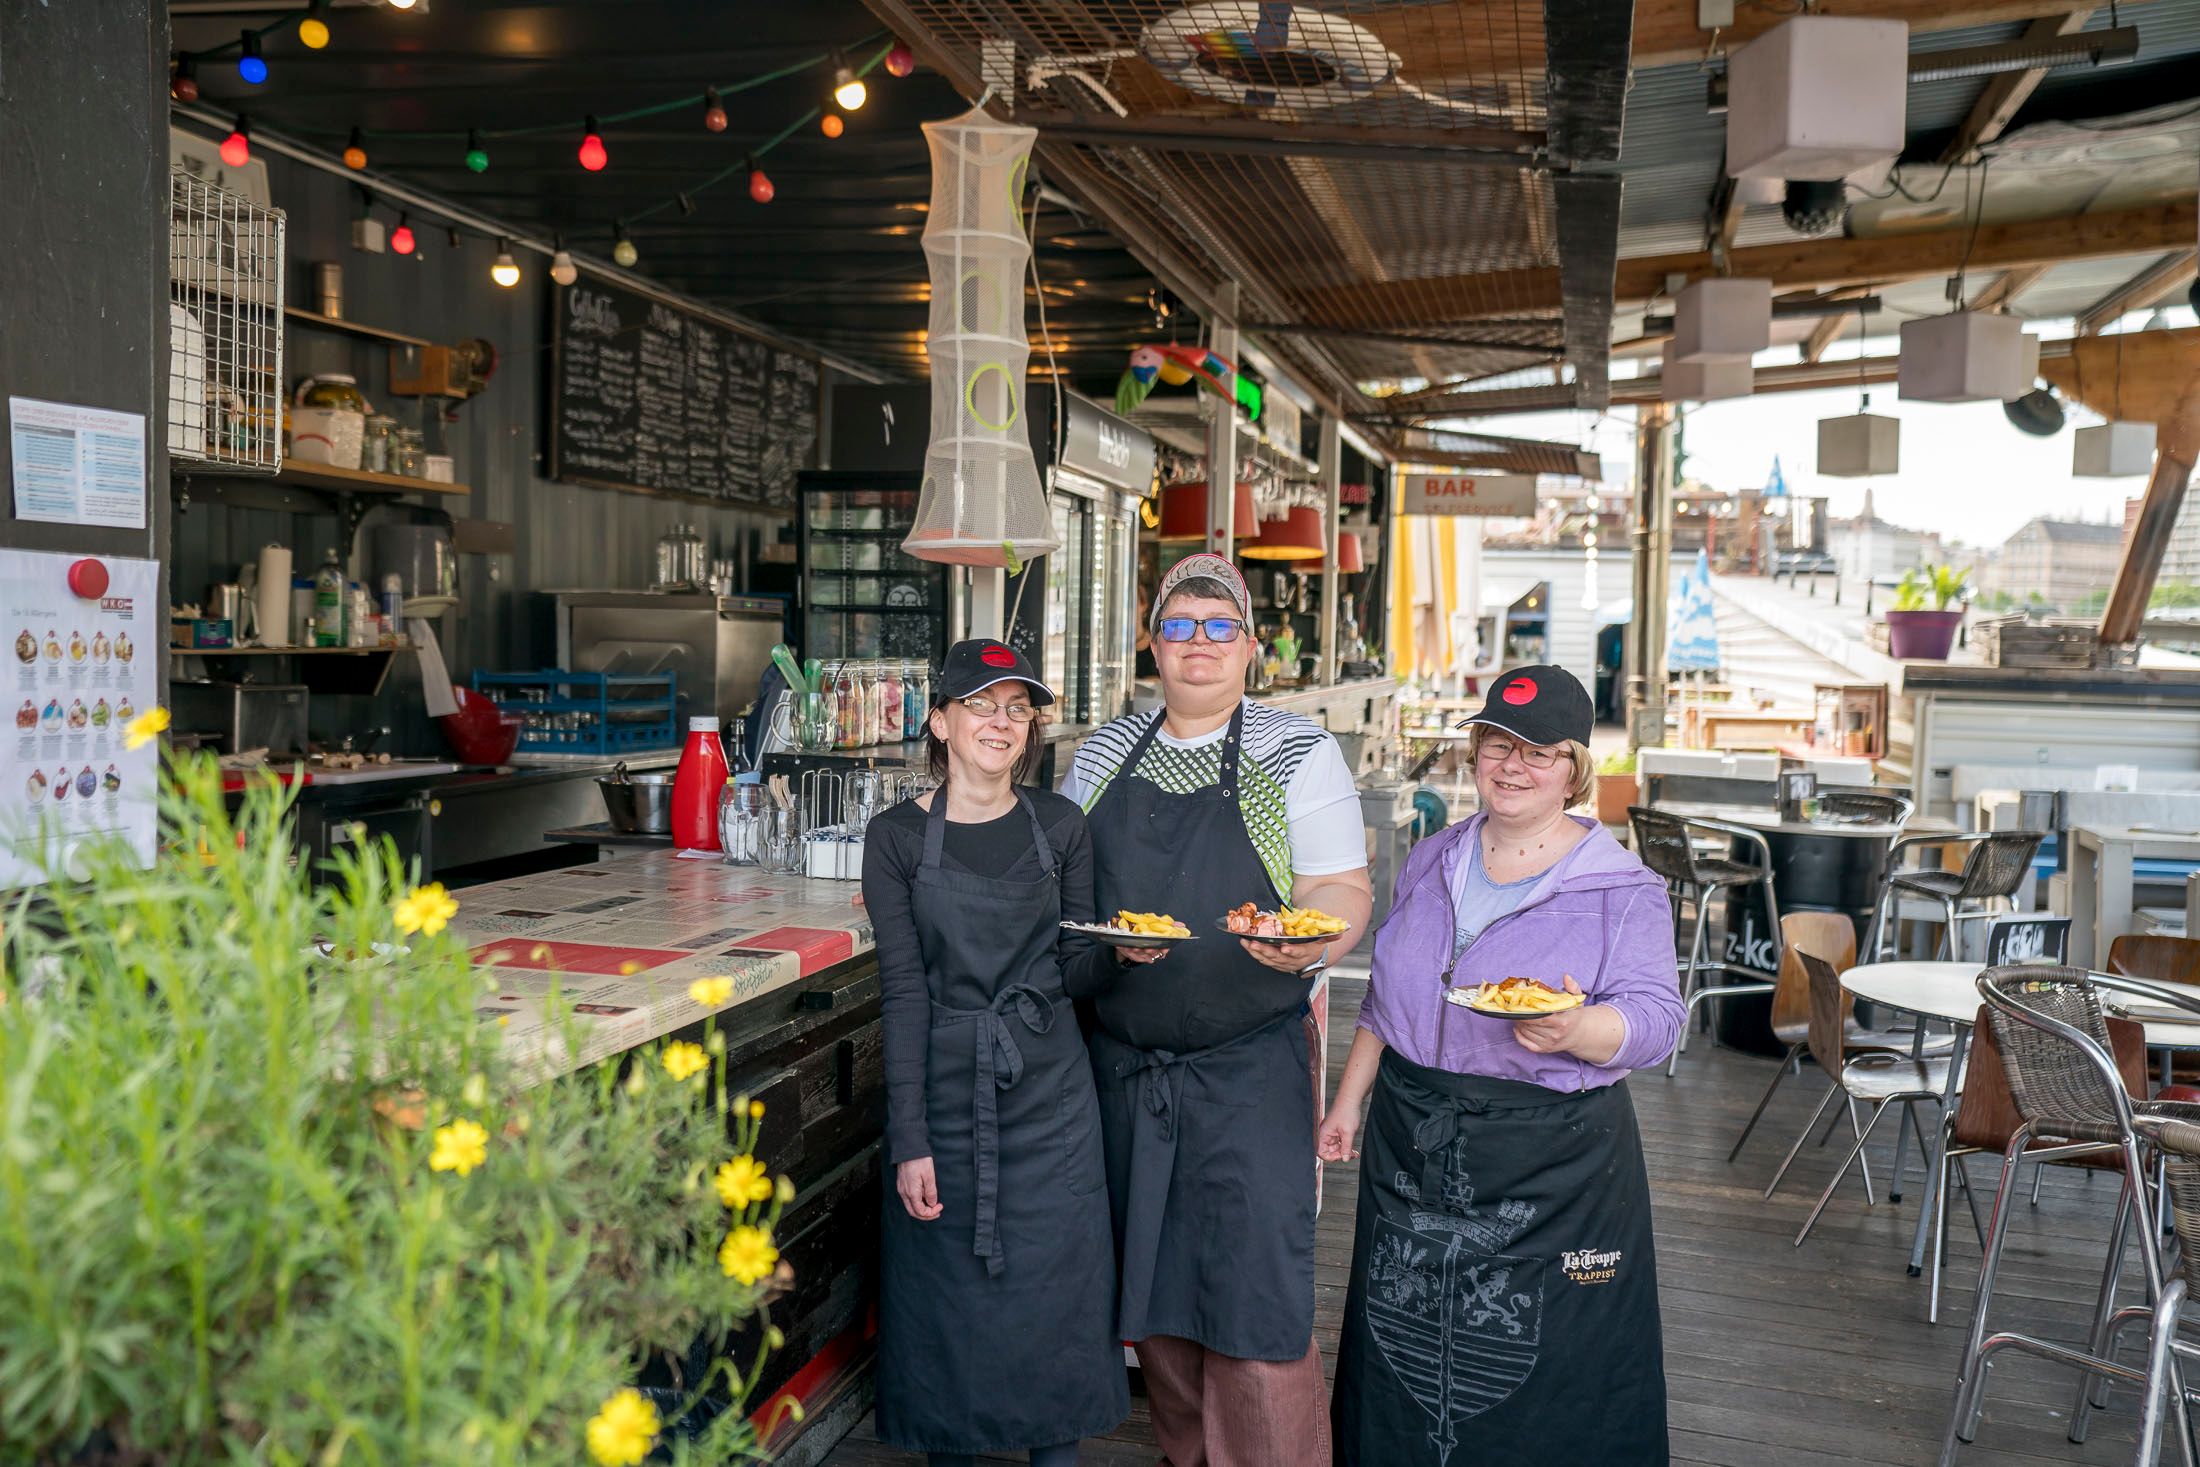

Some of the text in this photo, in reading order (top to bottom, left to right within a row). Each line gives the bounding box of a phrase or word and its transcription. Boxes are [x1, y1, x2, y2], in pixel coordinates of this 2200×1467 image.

[1424, 478, 1477, 497] BAR
[1561, 1248, 1622, 1273] La Trappe
[1568, 1269, 1616, 1281] TRAPPIST
